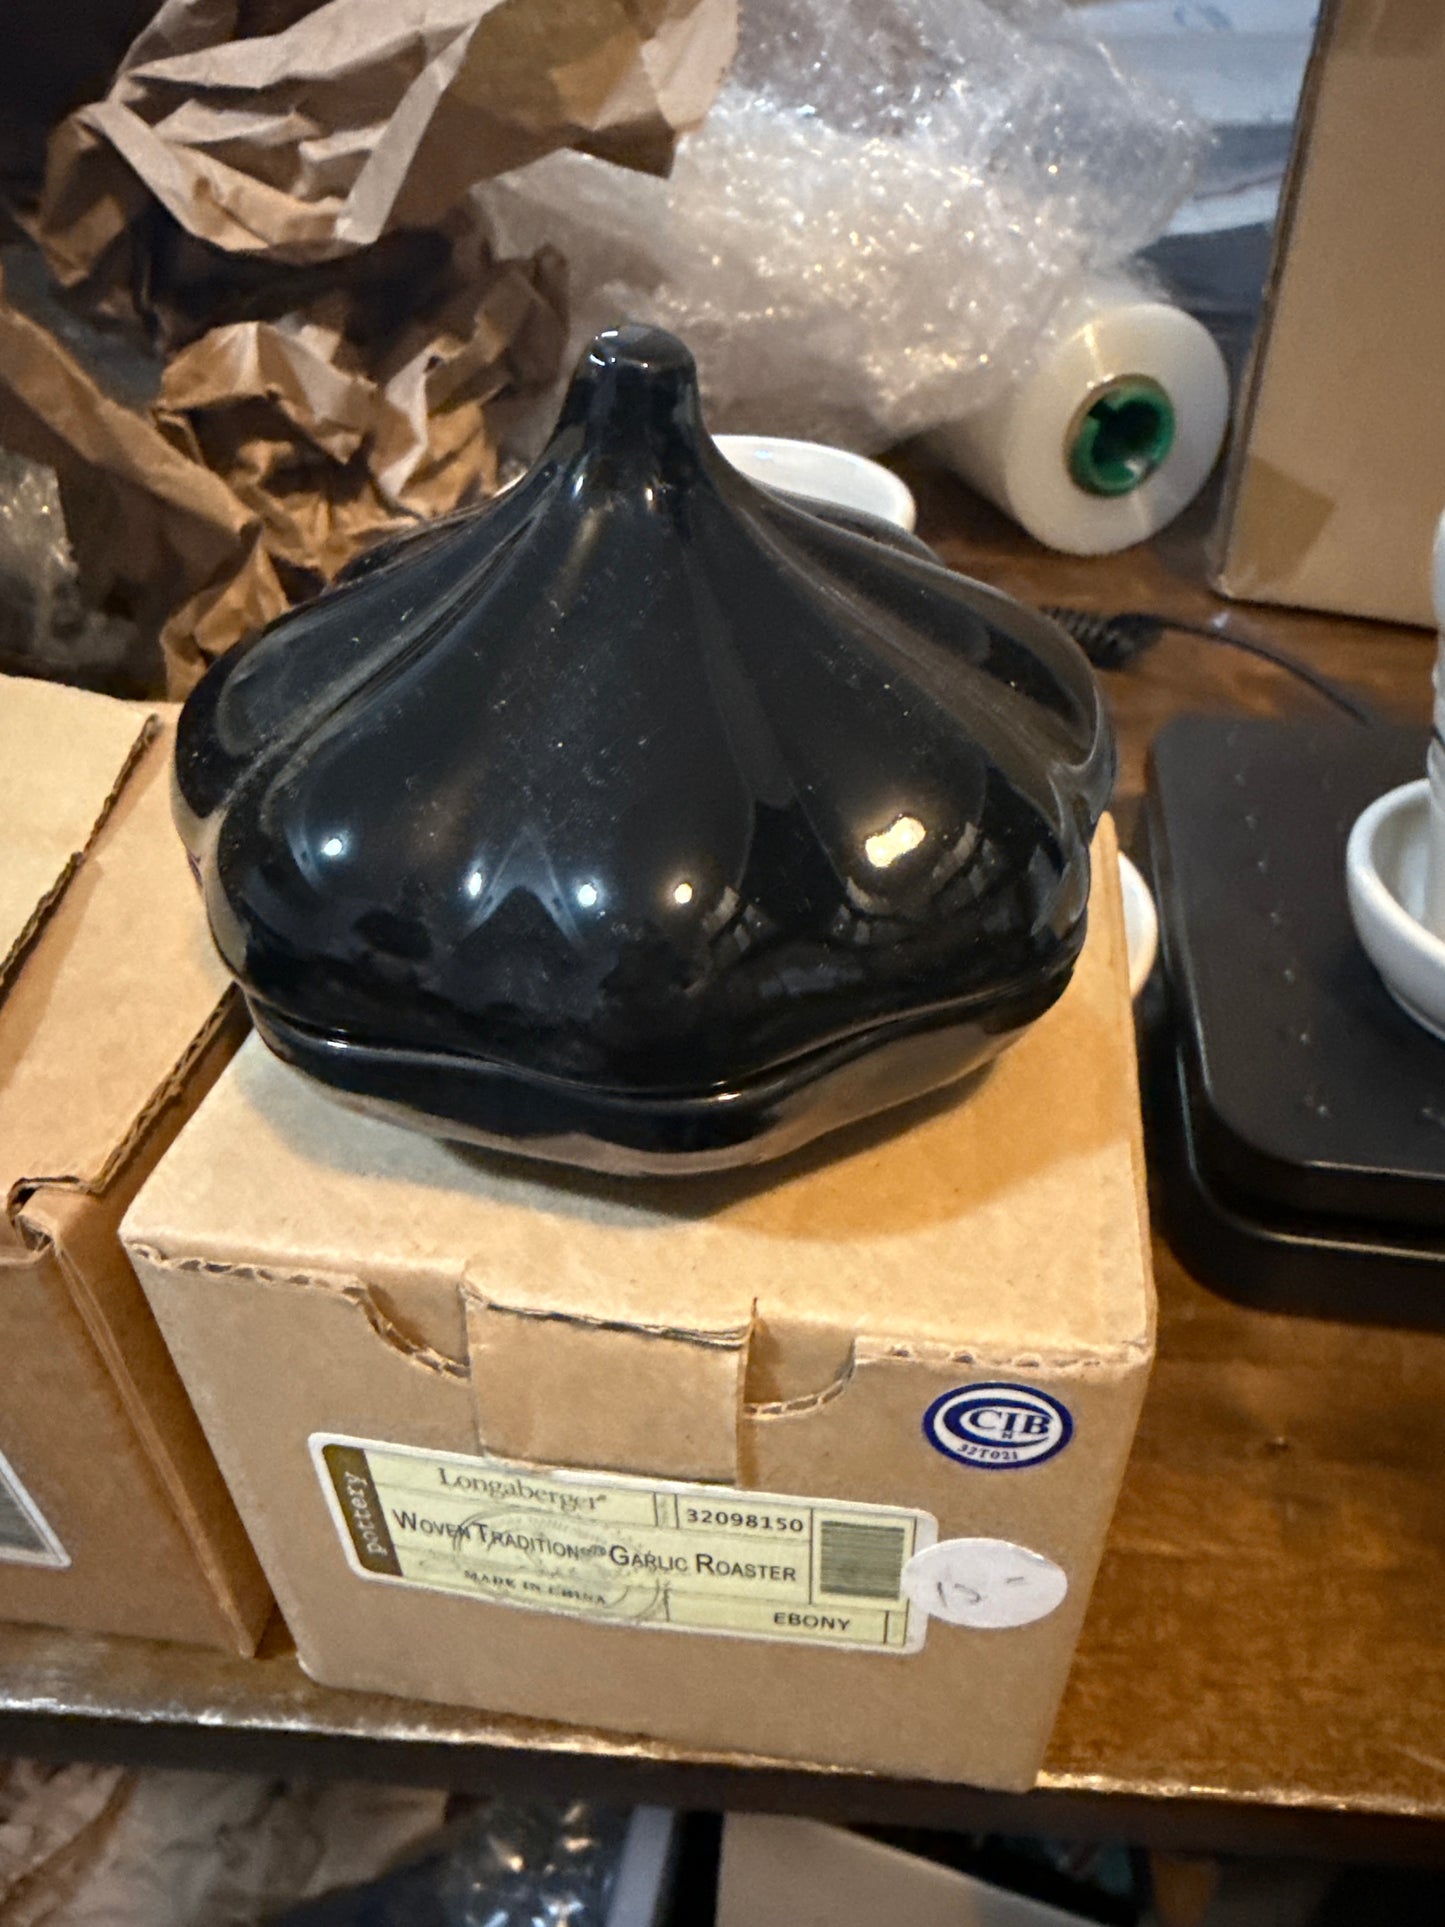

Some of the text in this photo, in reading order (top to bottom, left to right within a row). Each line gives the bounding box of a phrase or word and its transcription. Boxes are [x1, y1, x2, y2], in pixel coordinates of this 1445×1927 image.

[344, 1471, 389, 1556] pottery
[686, 1508, 804, 1533] 32098150
[773, 1611, 851, 1632] EBONY
